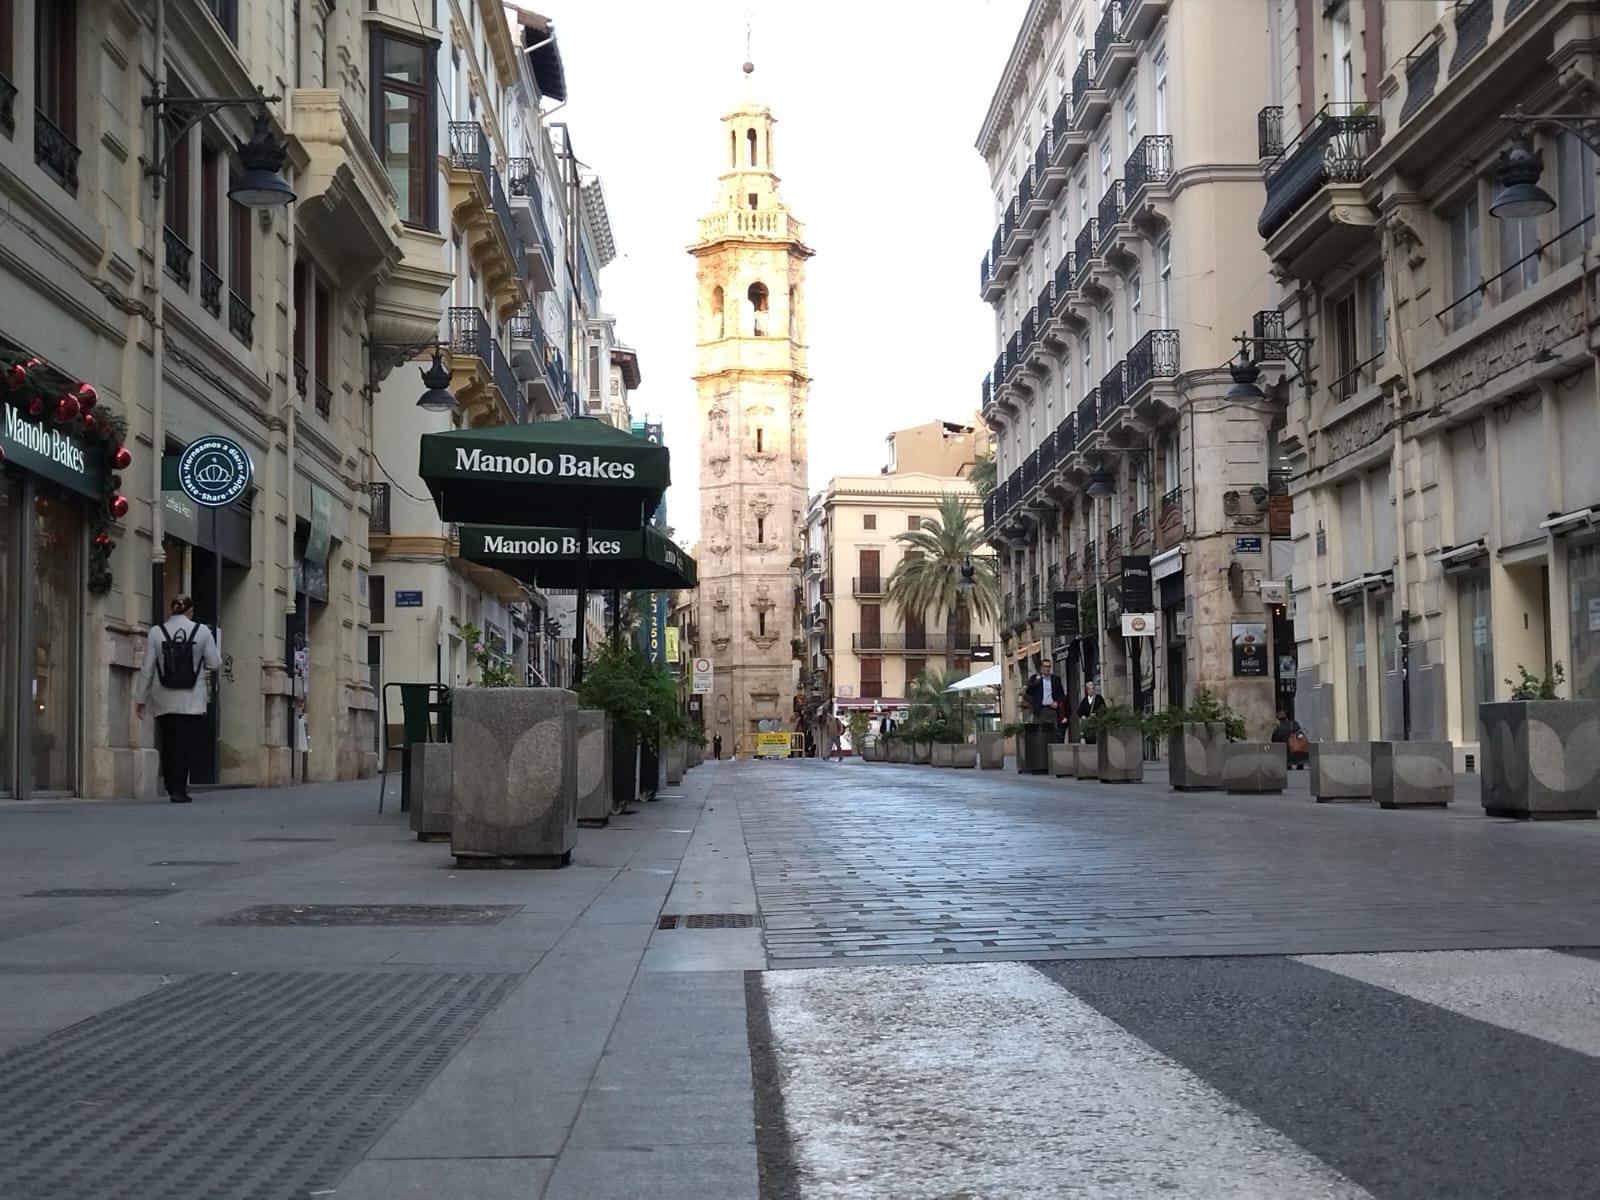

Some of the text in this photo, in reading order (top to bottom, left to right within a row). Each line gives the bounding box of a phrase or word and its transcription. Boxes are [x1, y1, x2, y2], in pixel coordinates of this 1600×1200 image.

[5, 402, 85, 474] Manolo Bakes
[183, 442, 221, 471] Horneamos
[228, 448, 244, 470] diario
[455, 447, 636, 480] Manolo Bakes
[184, 474, 246, 501] Taste Share Enjoy
[483, 535, 558, 554] Manolo
